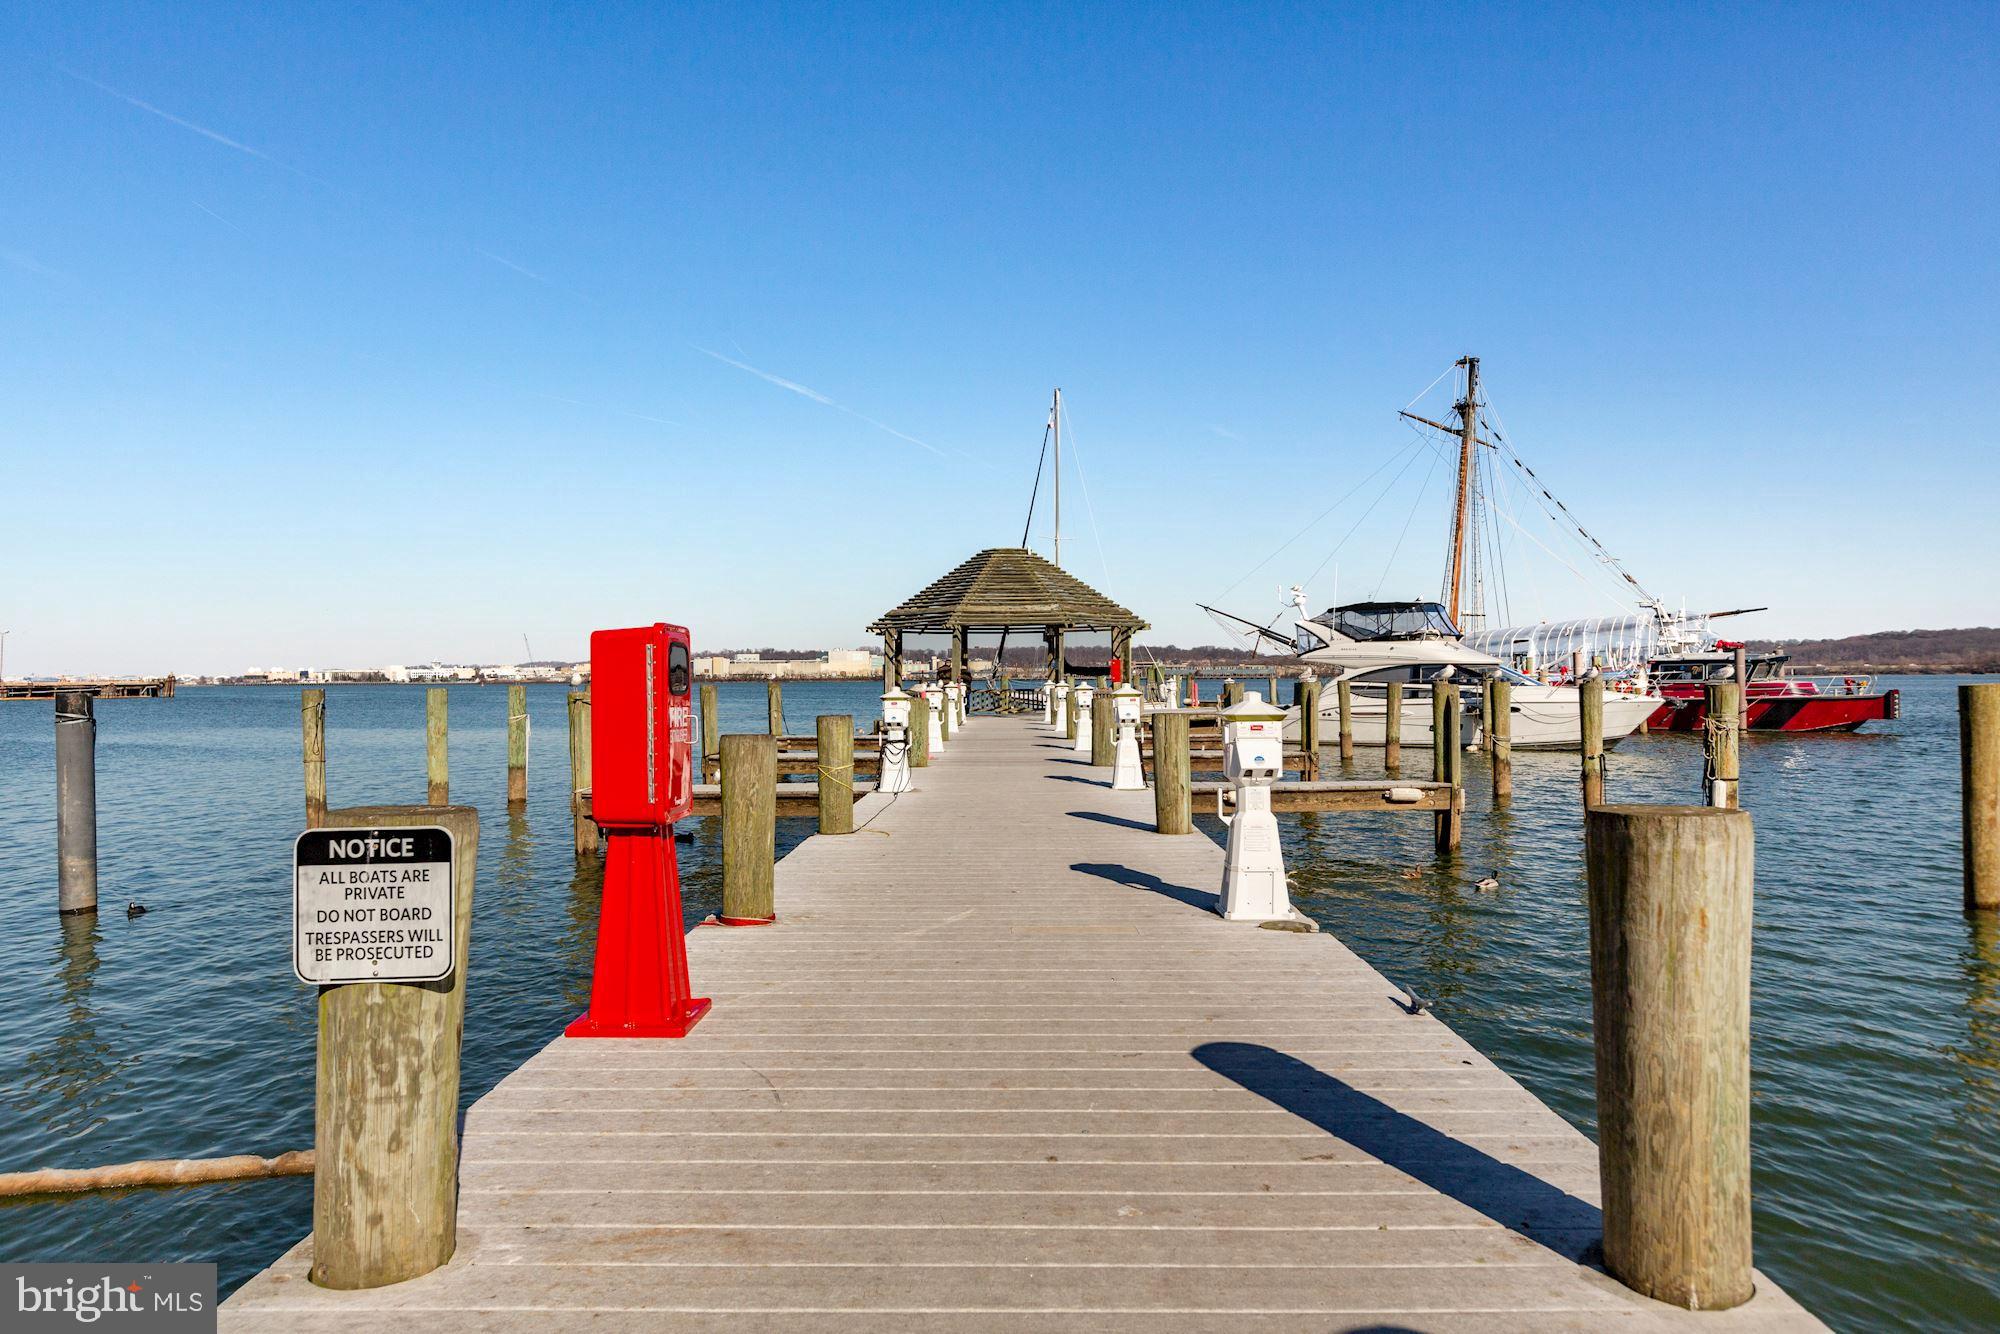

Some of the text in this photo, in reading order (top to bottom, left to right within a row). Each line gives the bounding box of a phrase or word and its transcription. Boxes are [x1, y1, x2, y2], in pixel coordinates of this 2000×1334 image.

[329, 838, 414, 859] NOTICE
[319, 869, 430, 885] ALL BOATS ARE
[345, 886, 405, 900] PRIVATE
[317, 907, 432, 923] DO NOT BOARD
[305, 929, 443, 945] TRESPASSERS WILL
[315, 946, 433, 961] BE PROSECUTED
